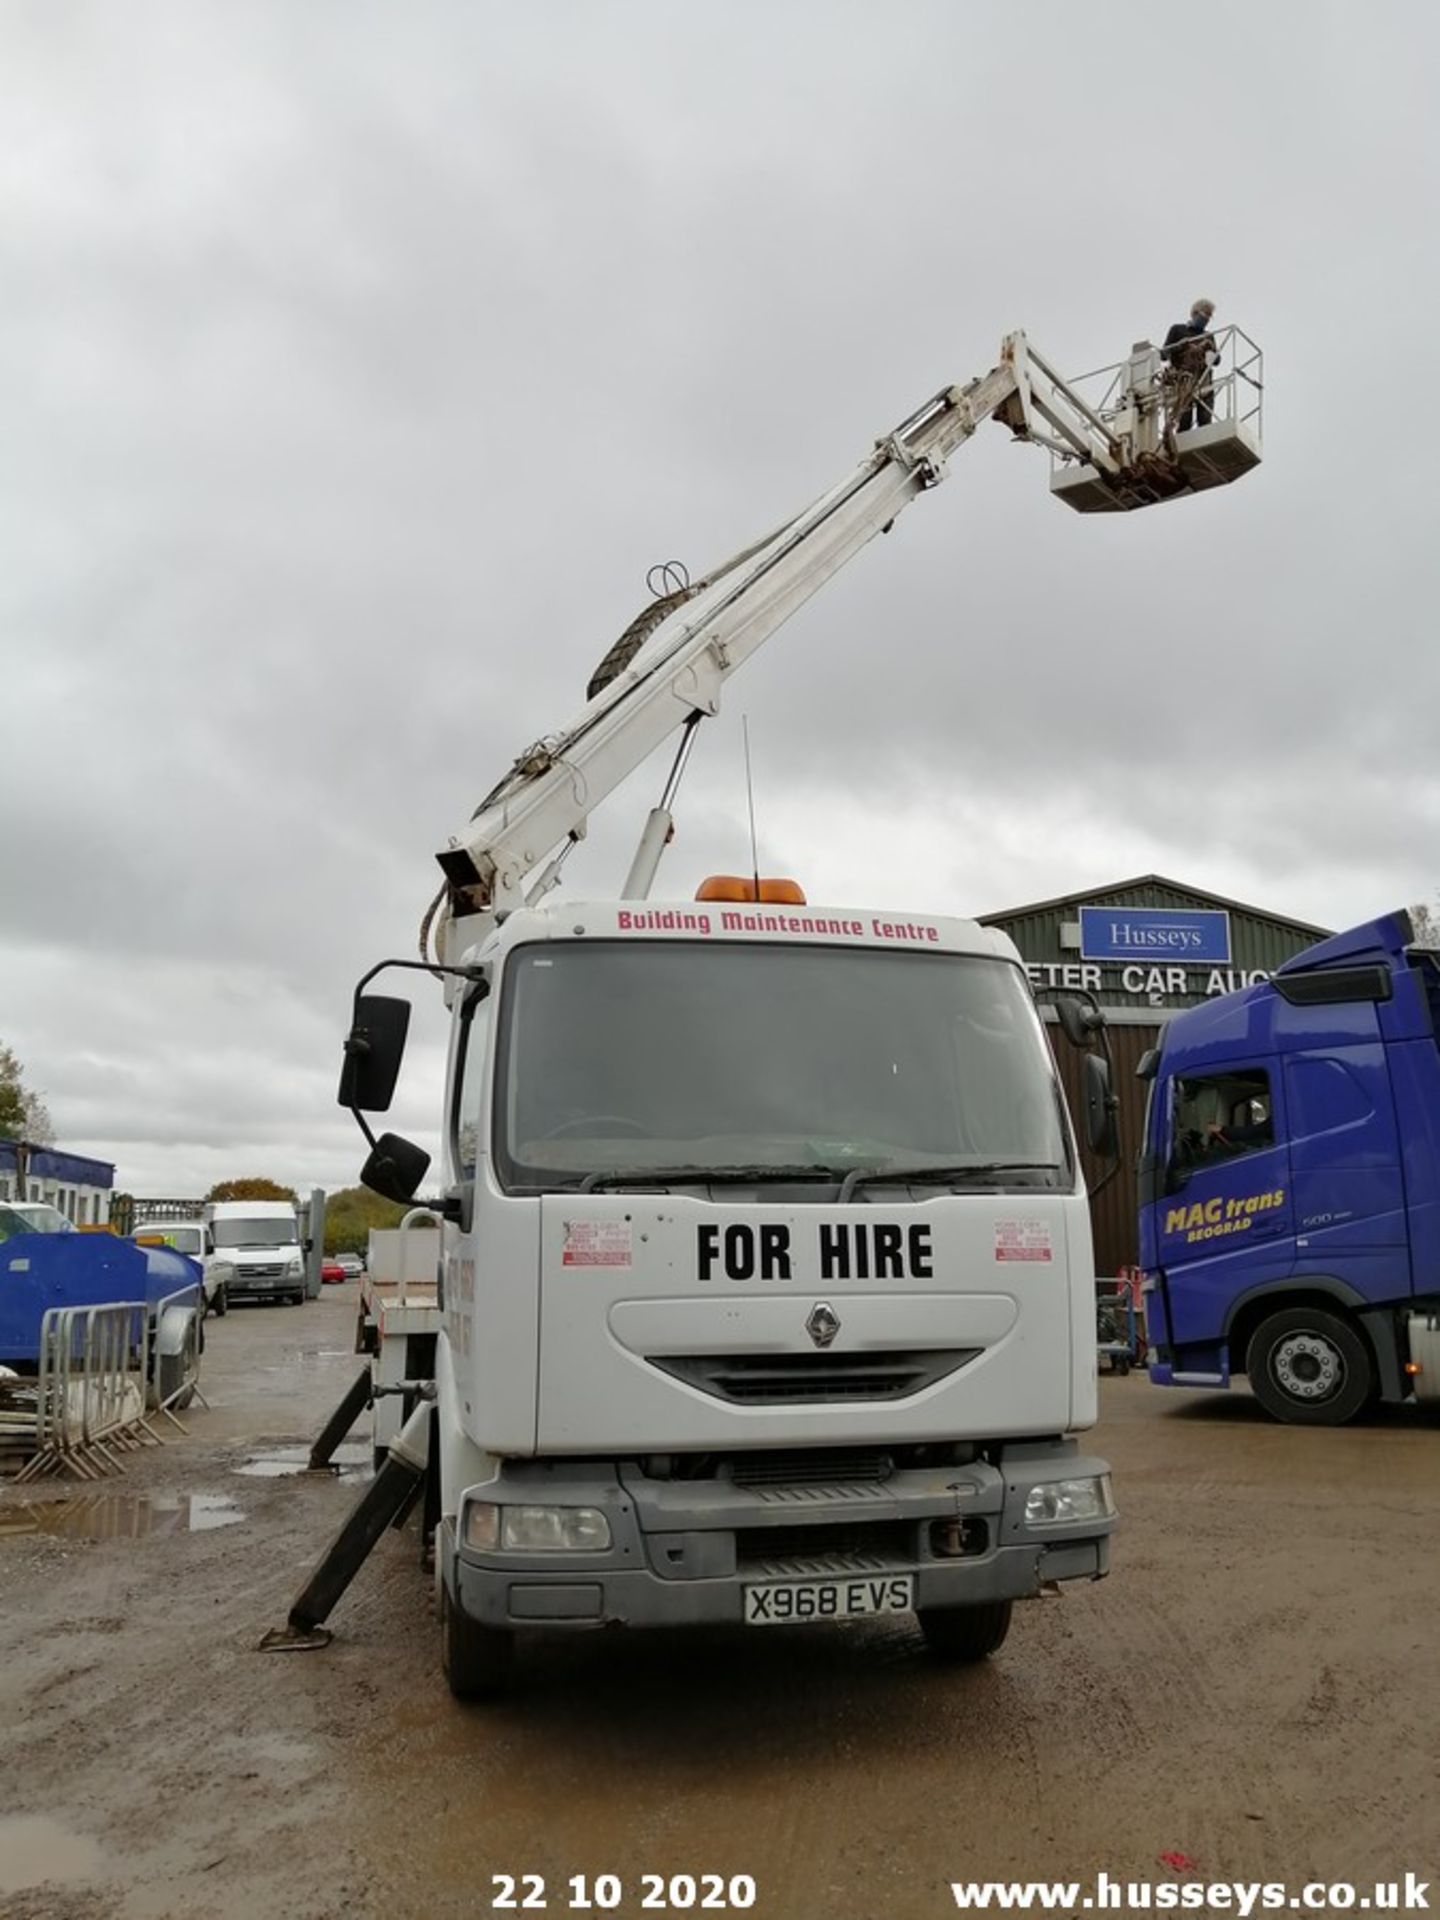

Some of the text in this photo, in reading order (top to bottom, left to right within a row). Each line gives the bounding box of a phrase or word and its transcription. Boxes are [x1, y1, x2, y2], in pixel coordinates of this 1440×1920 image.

[618, 911, 939, 942] Building Maintenance Centre
[1110, 923, 1202, 950] Husseys
[1122, 966, 1187, 993] CAR
[1206, 969, 1276, 995] AUC
[1165, 1190, 1285, 1234] MAG trans
[1187, 1217, 1252, 1243] BEOGRAD
[698, 1224, 791, 1281] FOR
[819, 1224, 933, 1279] HIRE
[751, 1581, 908, 1620] X968 EVS
